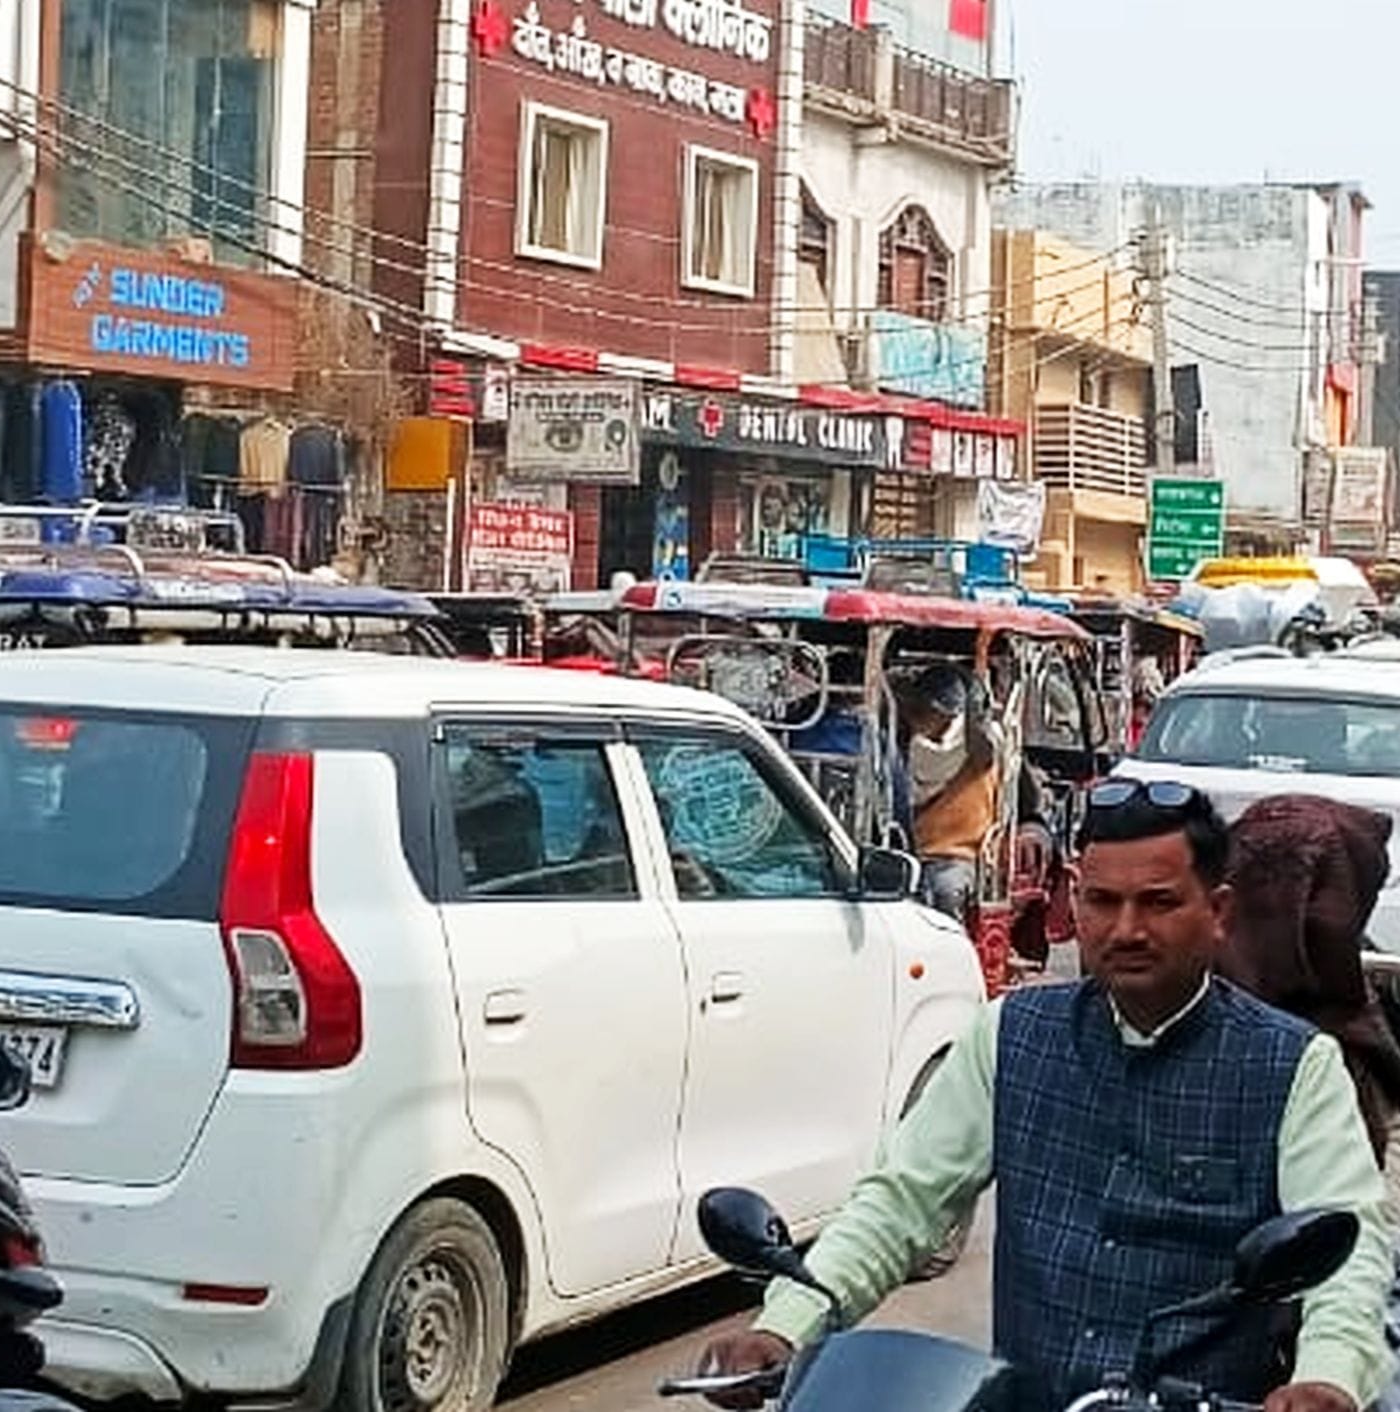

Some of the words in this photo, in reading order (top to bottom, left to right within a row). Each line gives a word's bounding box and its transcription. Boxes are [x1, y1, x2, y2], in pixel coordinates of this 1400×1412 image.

[110, 266, 225, 317] SUNDER
[91, 314, 250, 367] GARMENTS
[739, 404, 807, 446] DENTAL
[818, 416, 873, 452] CLINIC
